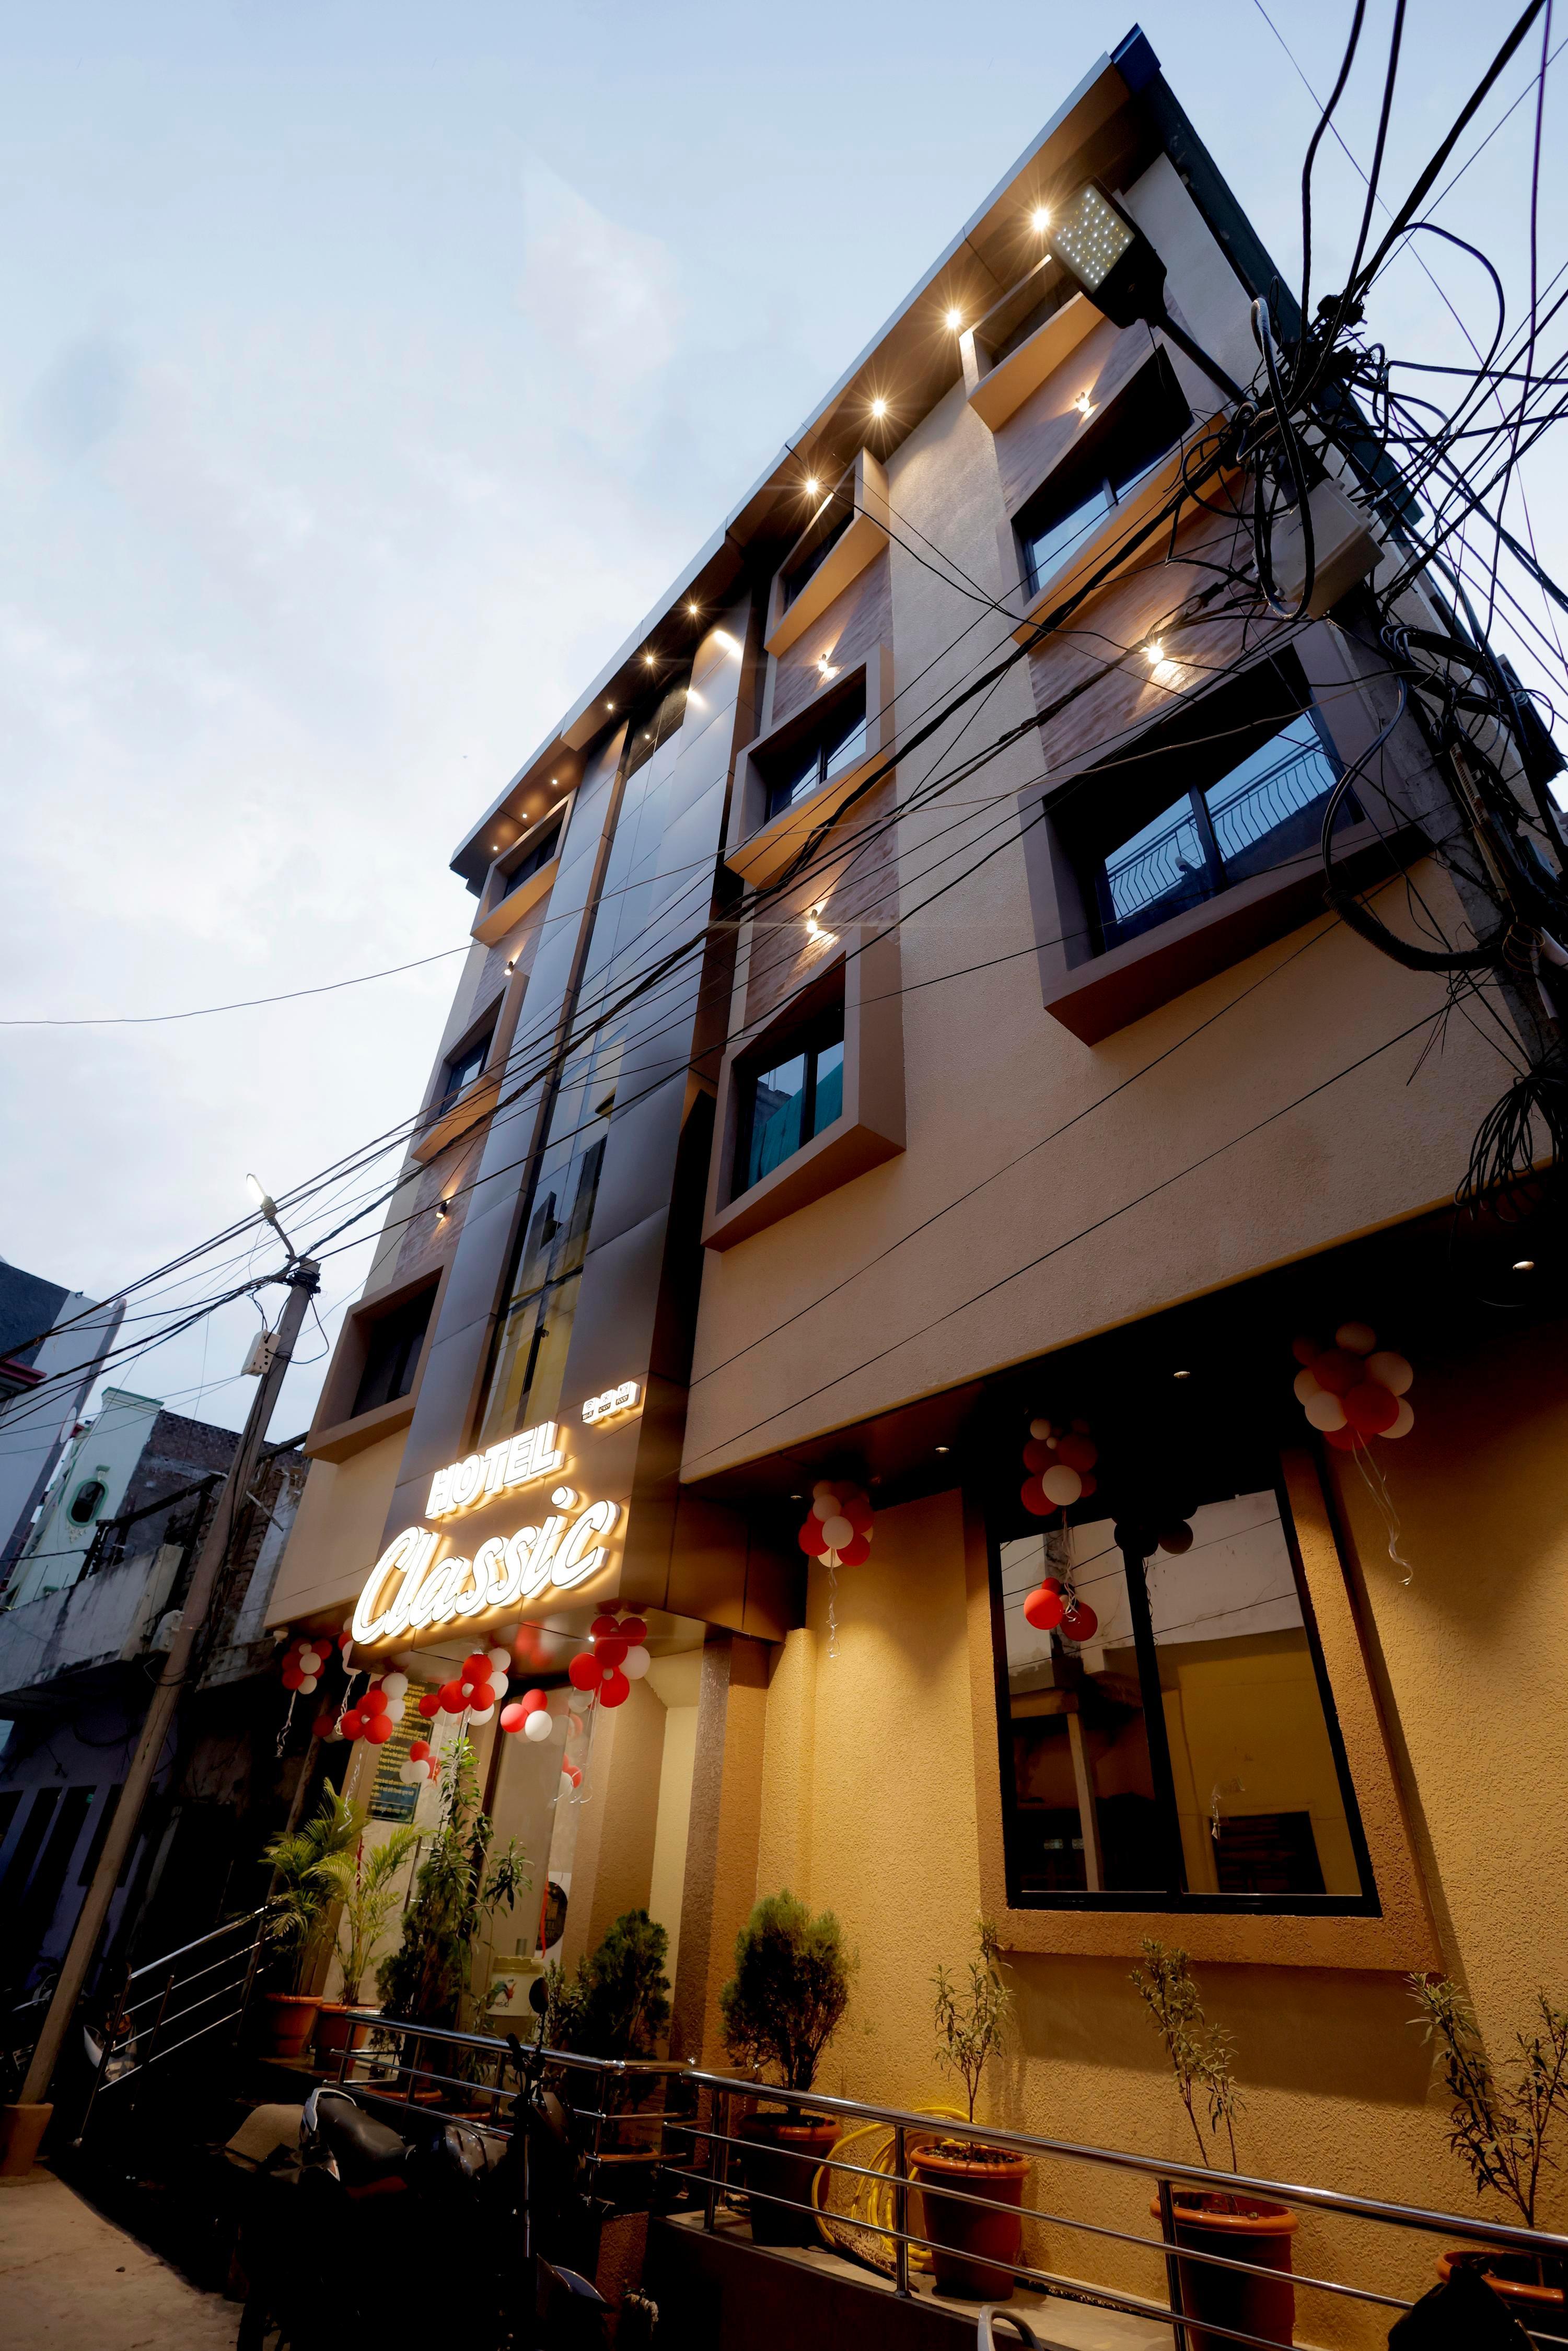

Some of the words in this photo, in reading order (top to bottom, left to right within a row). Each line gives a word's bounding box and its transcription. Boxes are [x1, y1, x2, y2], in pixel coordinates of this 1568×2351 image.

[617, 1396, 628, 1404] FOOD
[424, 1421, 565, 1520] HOTEL
[351, 1486, 620, 1645] Classic
